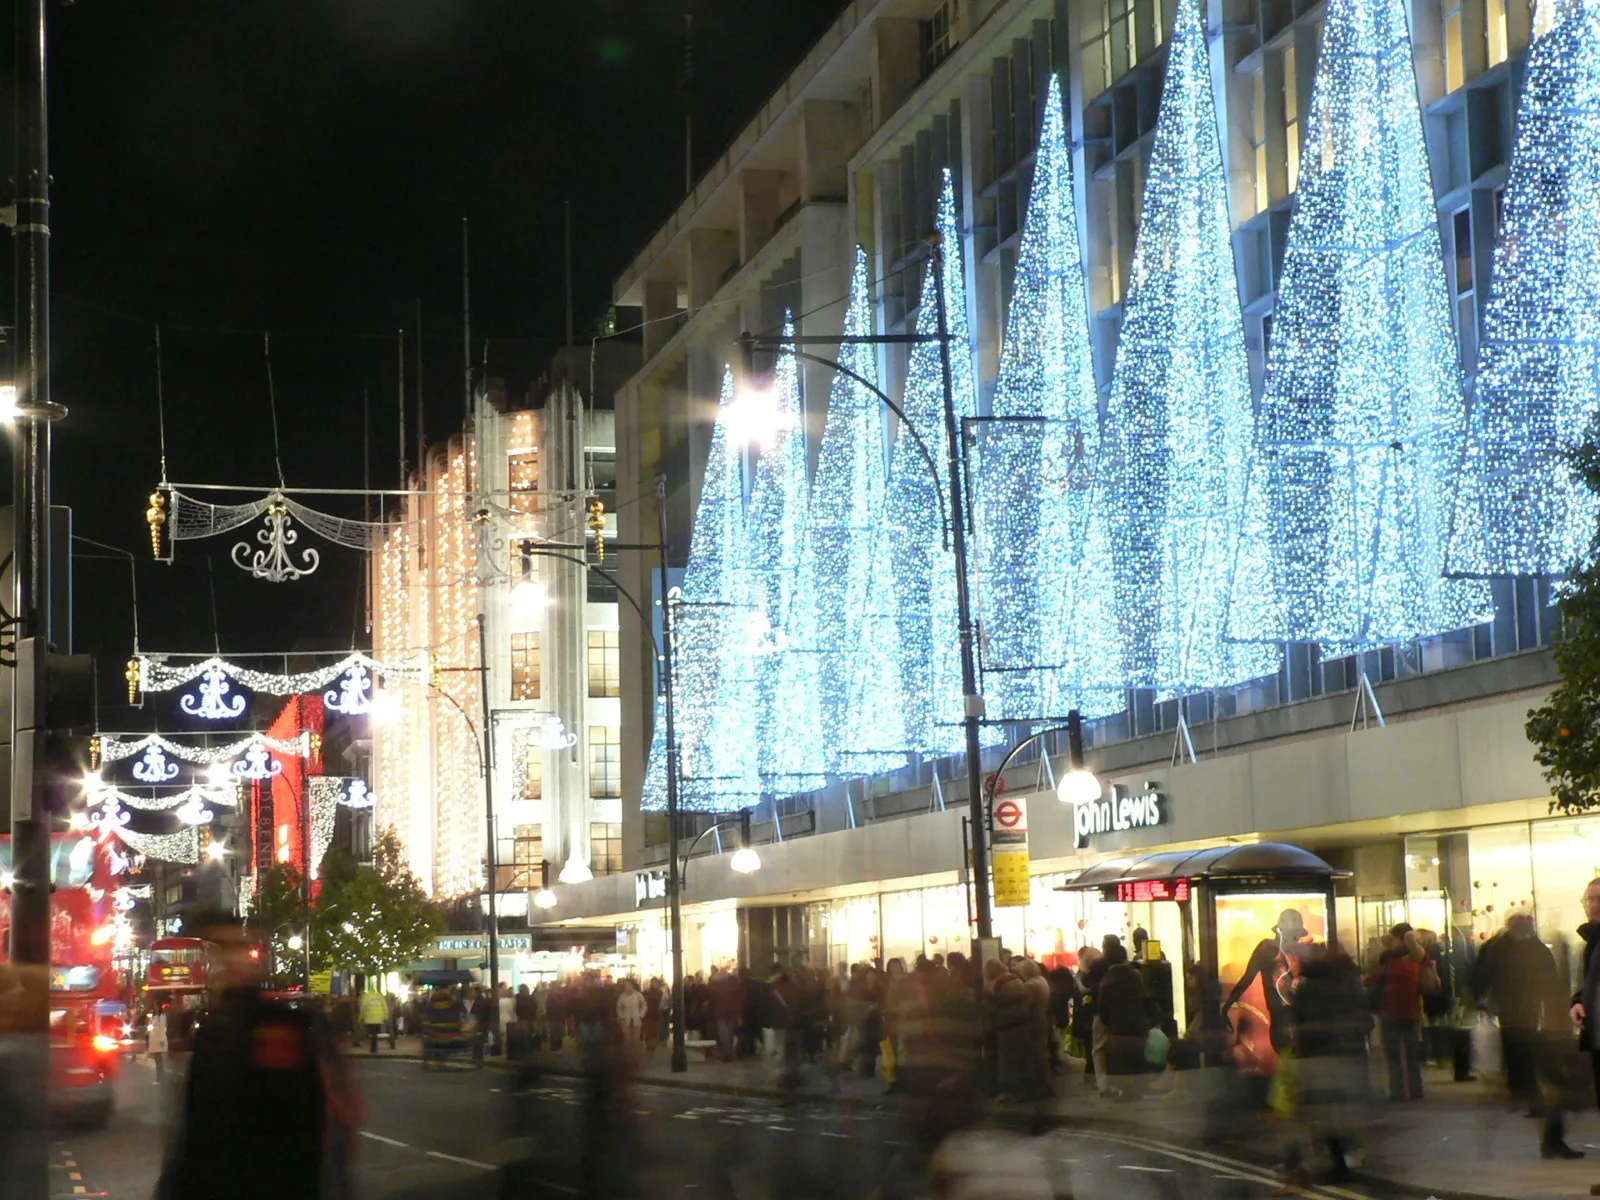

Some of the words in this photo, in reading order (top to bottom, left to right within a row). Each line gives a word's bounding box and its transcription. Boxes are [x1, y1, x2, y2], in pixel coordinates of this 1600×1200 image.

[1112, 781, 1159, 831] Lewis
[260, 791, 272, 872] DEBENH
[498, 938, 531, 948] RASER
